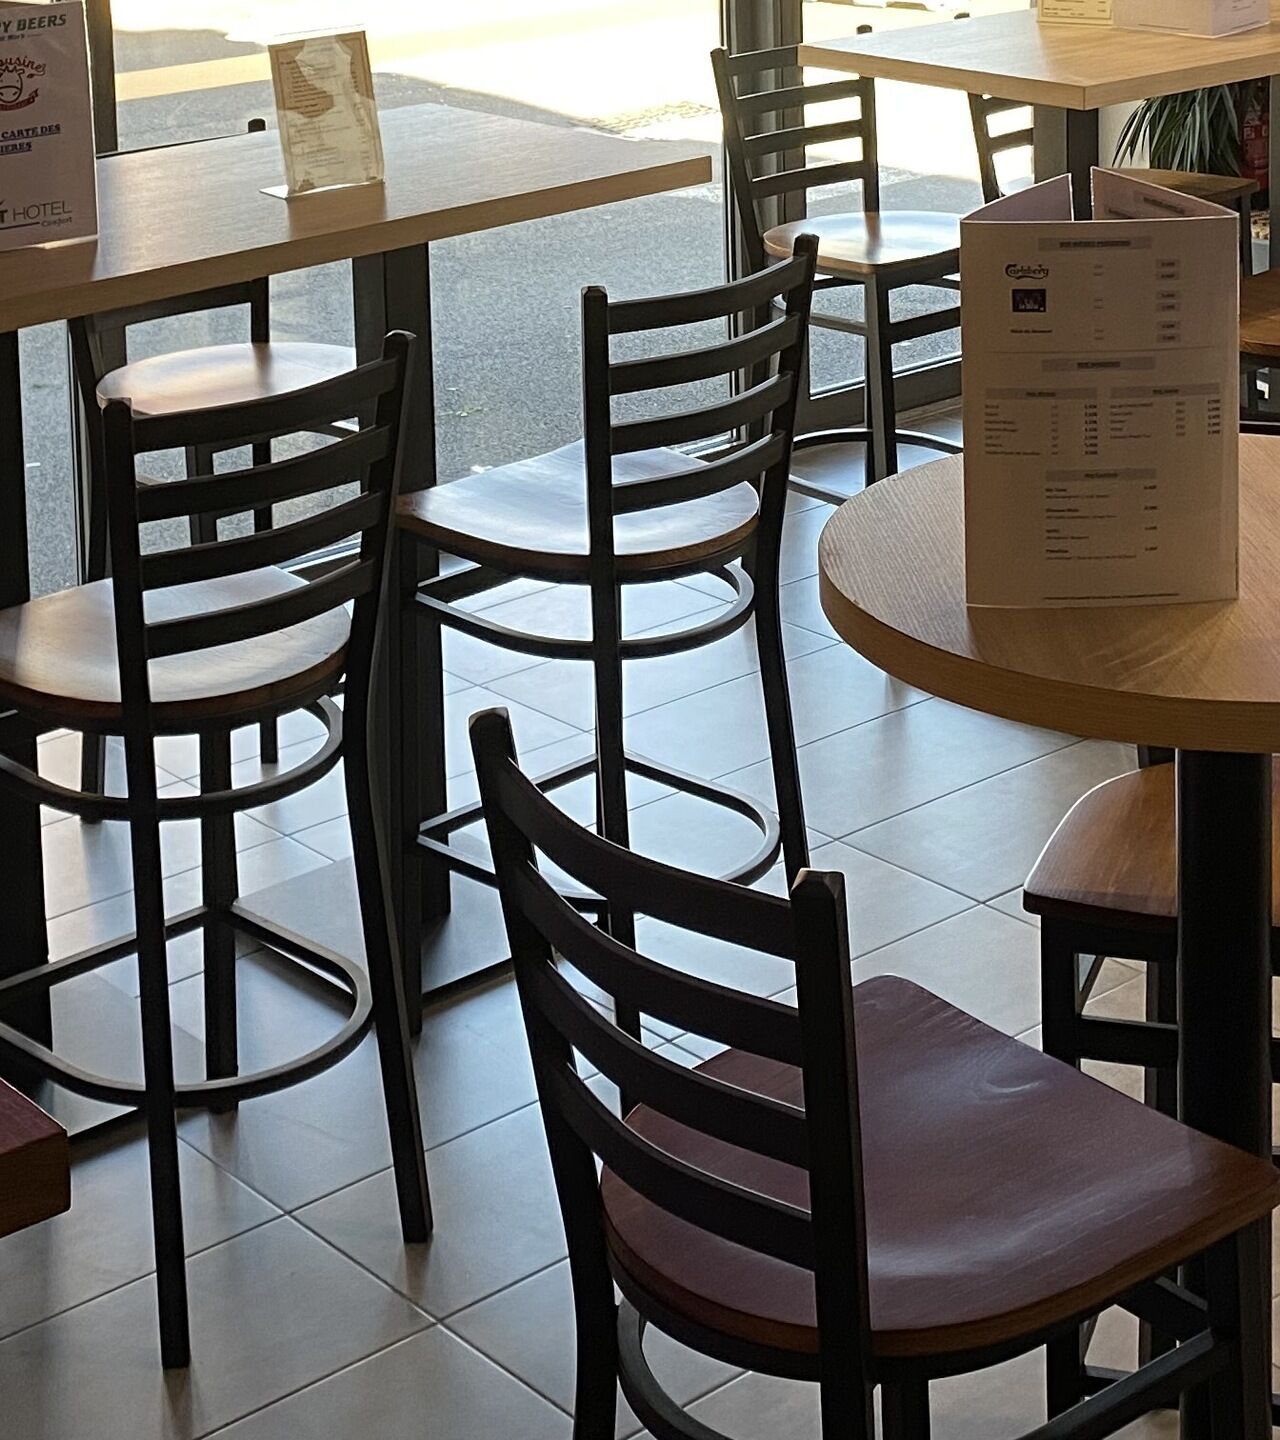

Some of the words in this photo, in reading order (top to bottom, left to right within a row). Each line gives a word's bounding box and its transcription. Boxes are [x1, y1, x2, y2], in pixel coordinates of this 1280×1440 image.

[16, 14, 67, 32] BEERS
[1, 126, 38, 140] CARTE
[40, 123, 61, 134] DES
[12, 200, 73, 221] HOTEL
